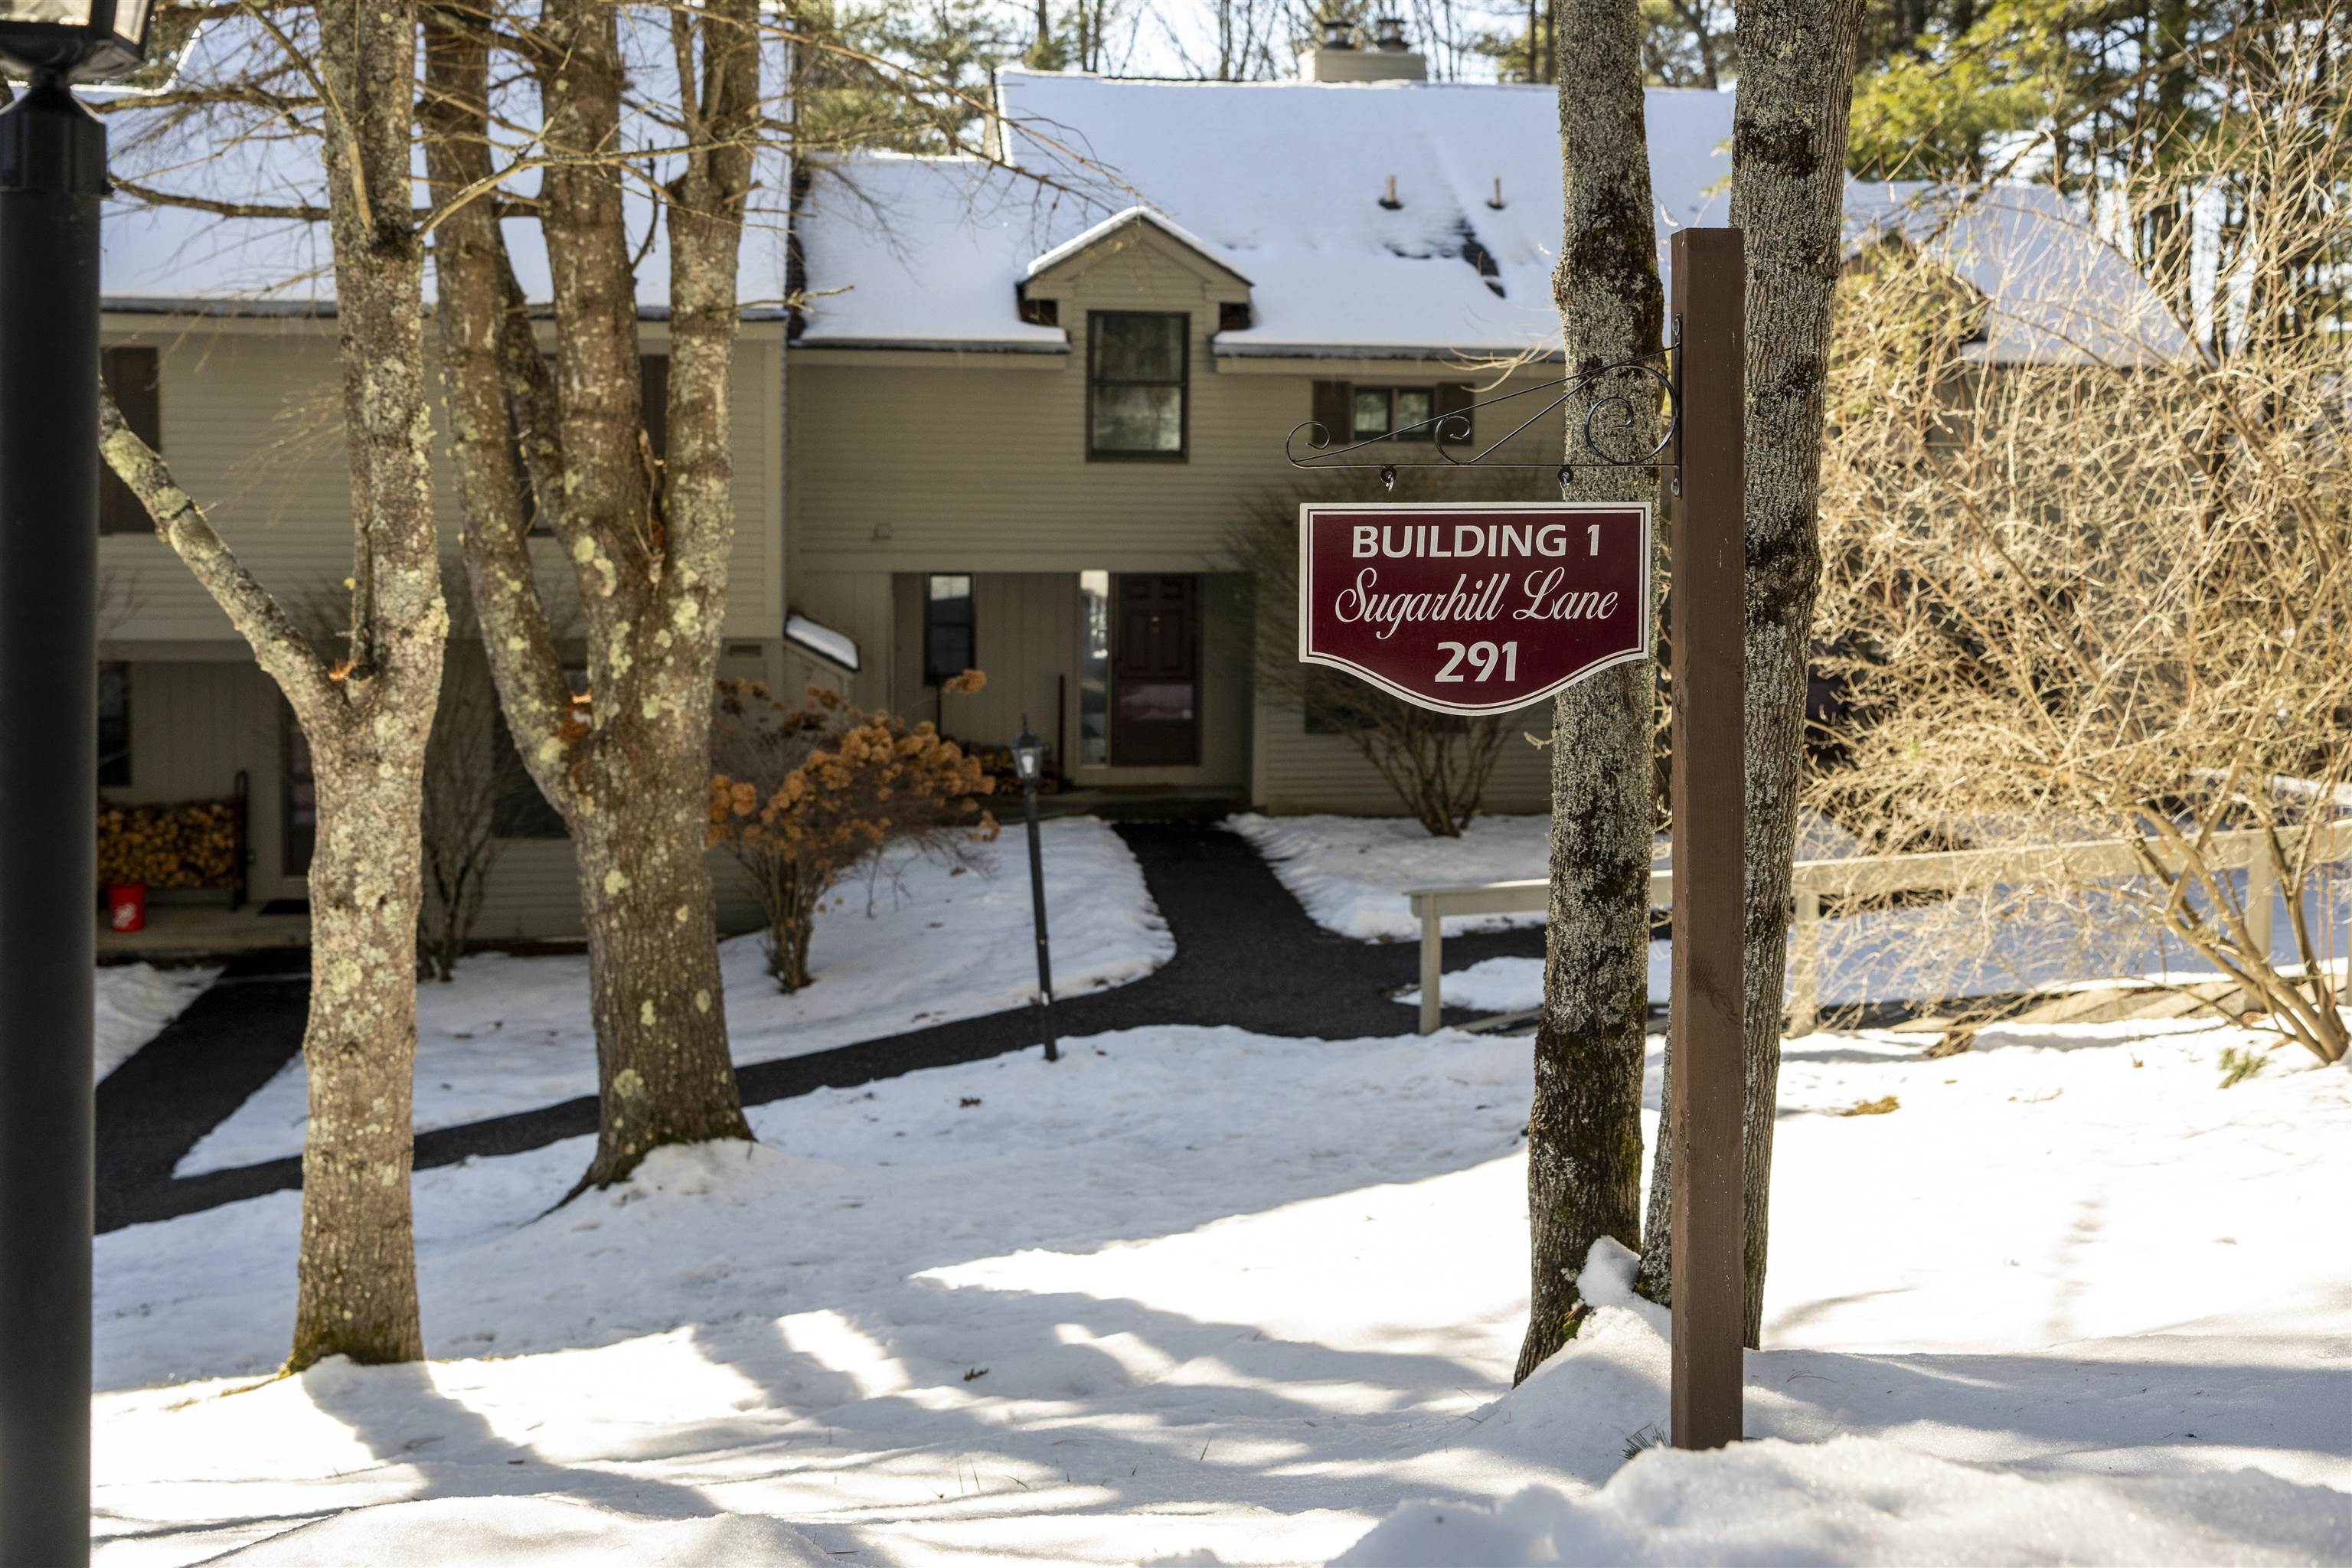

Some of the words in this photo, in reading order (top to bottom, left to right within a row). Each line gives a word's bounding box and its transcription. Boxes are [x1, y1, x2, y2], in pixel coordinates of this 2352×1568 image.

[1352, 524, 1567, 558] BUILDING
[1587, 524, 1600, 556] 1
[1334, 567, 1511, 640] Sugarhill
[1512, 567, 1619, 620] Lane
[1434, 641, 1518, 683] 291
